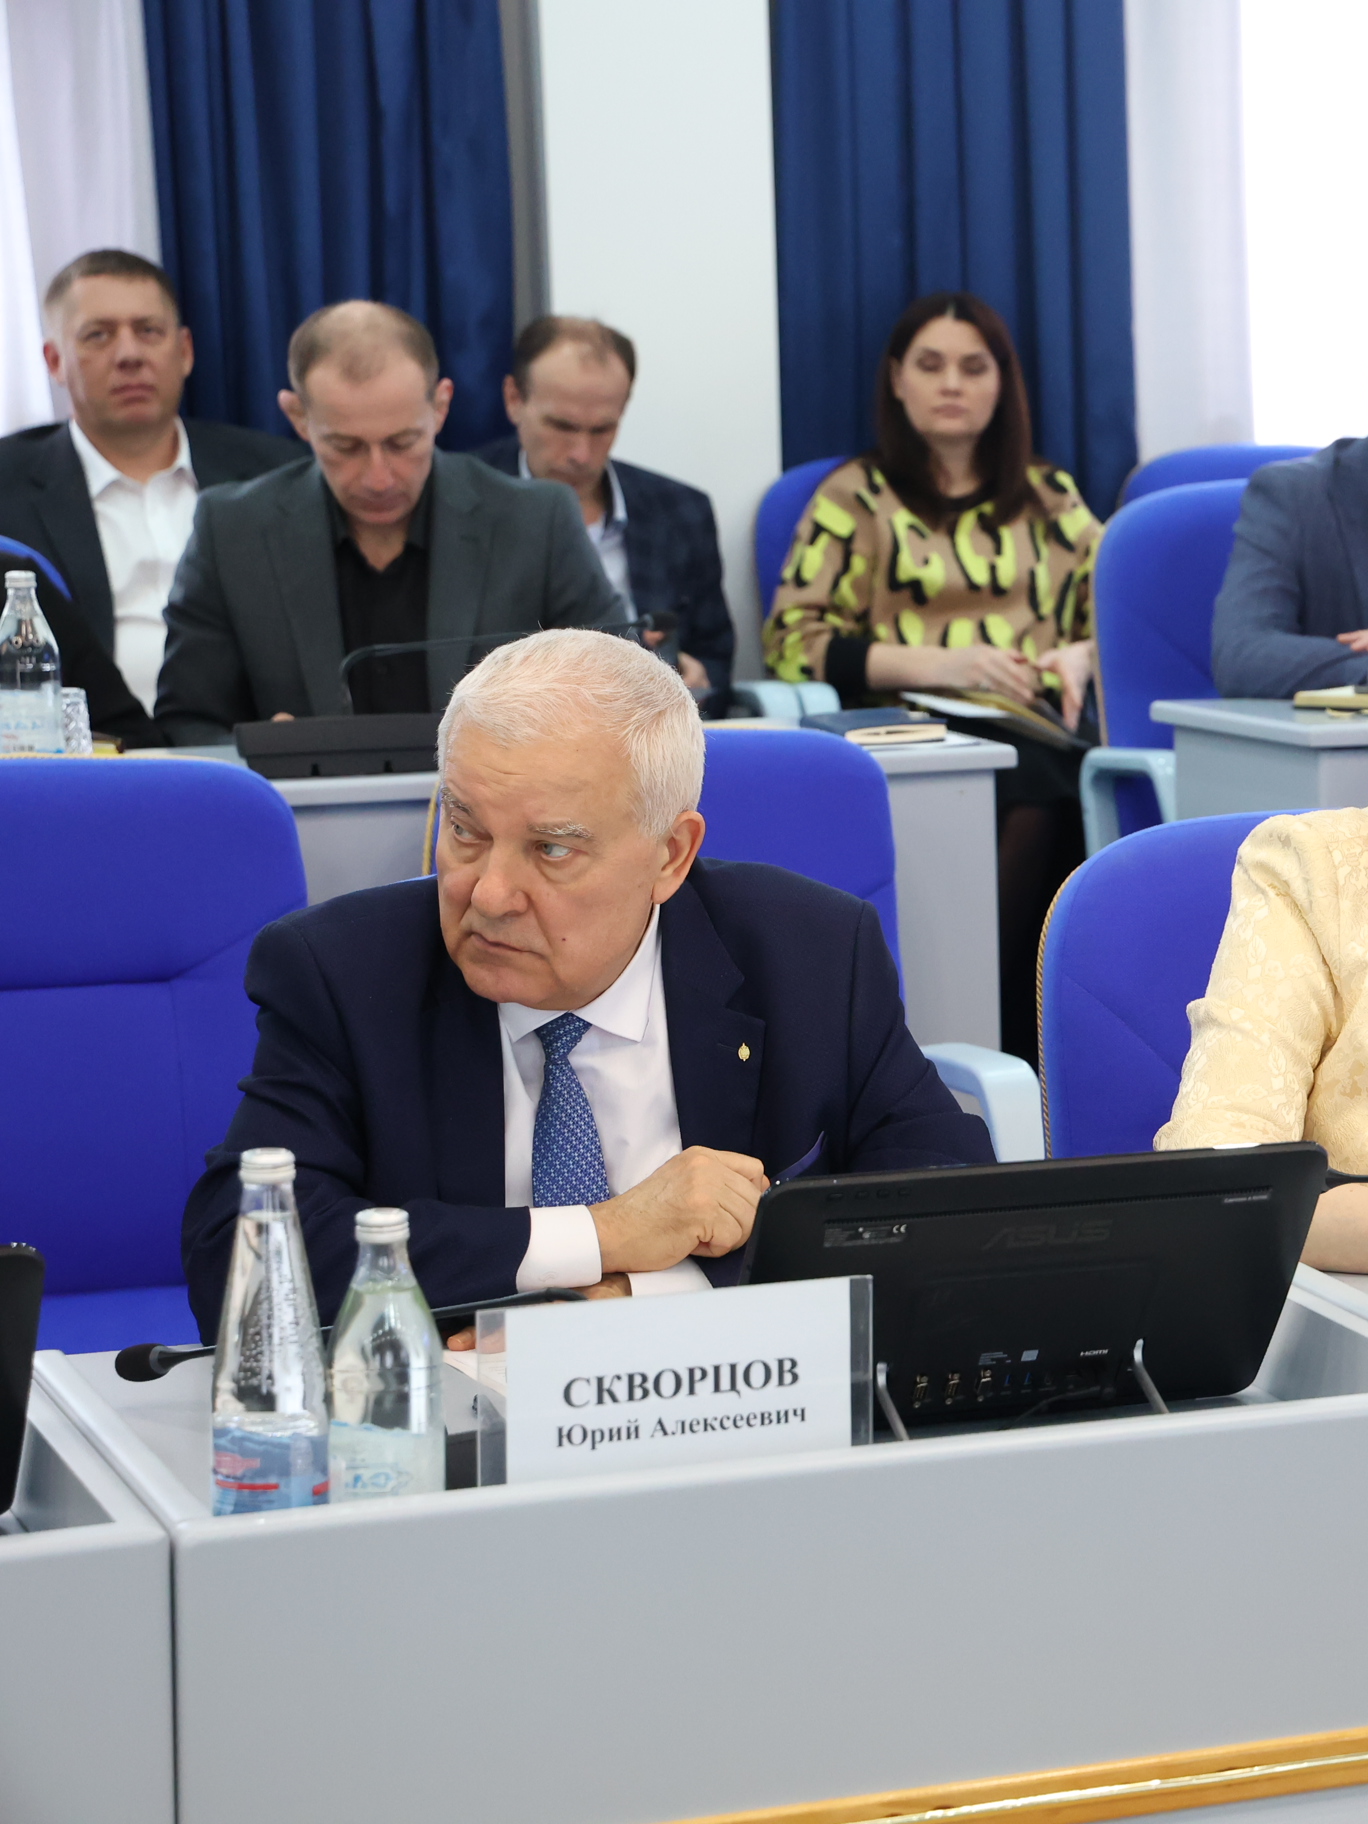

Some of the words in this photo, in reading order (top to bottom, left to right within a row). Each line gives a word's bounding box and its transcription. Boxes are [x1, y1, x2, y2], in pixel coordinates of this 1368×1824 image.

[980, 1219, 1113, 1251] ASUS
[1079, 1348, 1109, 1357] HDMI
[562, 1356, 800, 1409] СКВОРЦОВ
[556, 1419, 641, 1451] Юрий
[649, 1406, 807, 1438] Алексеевич
